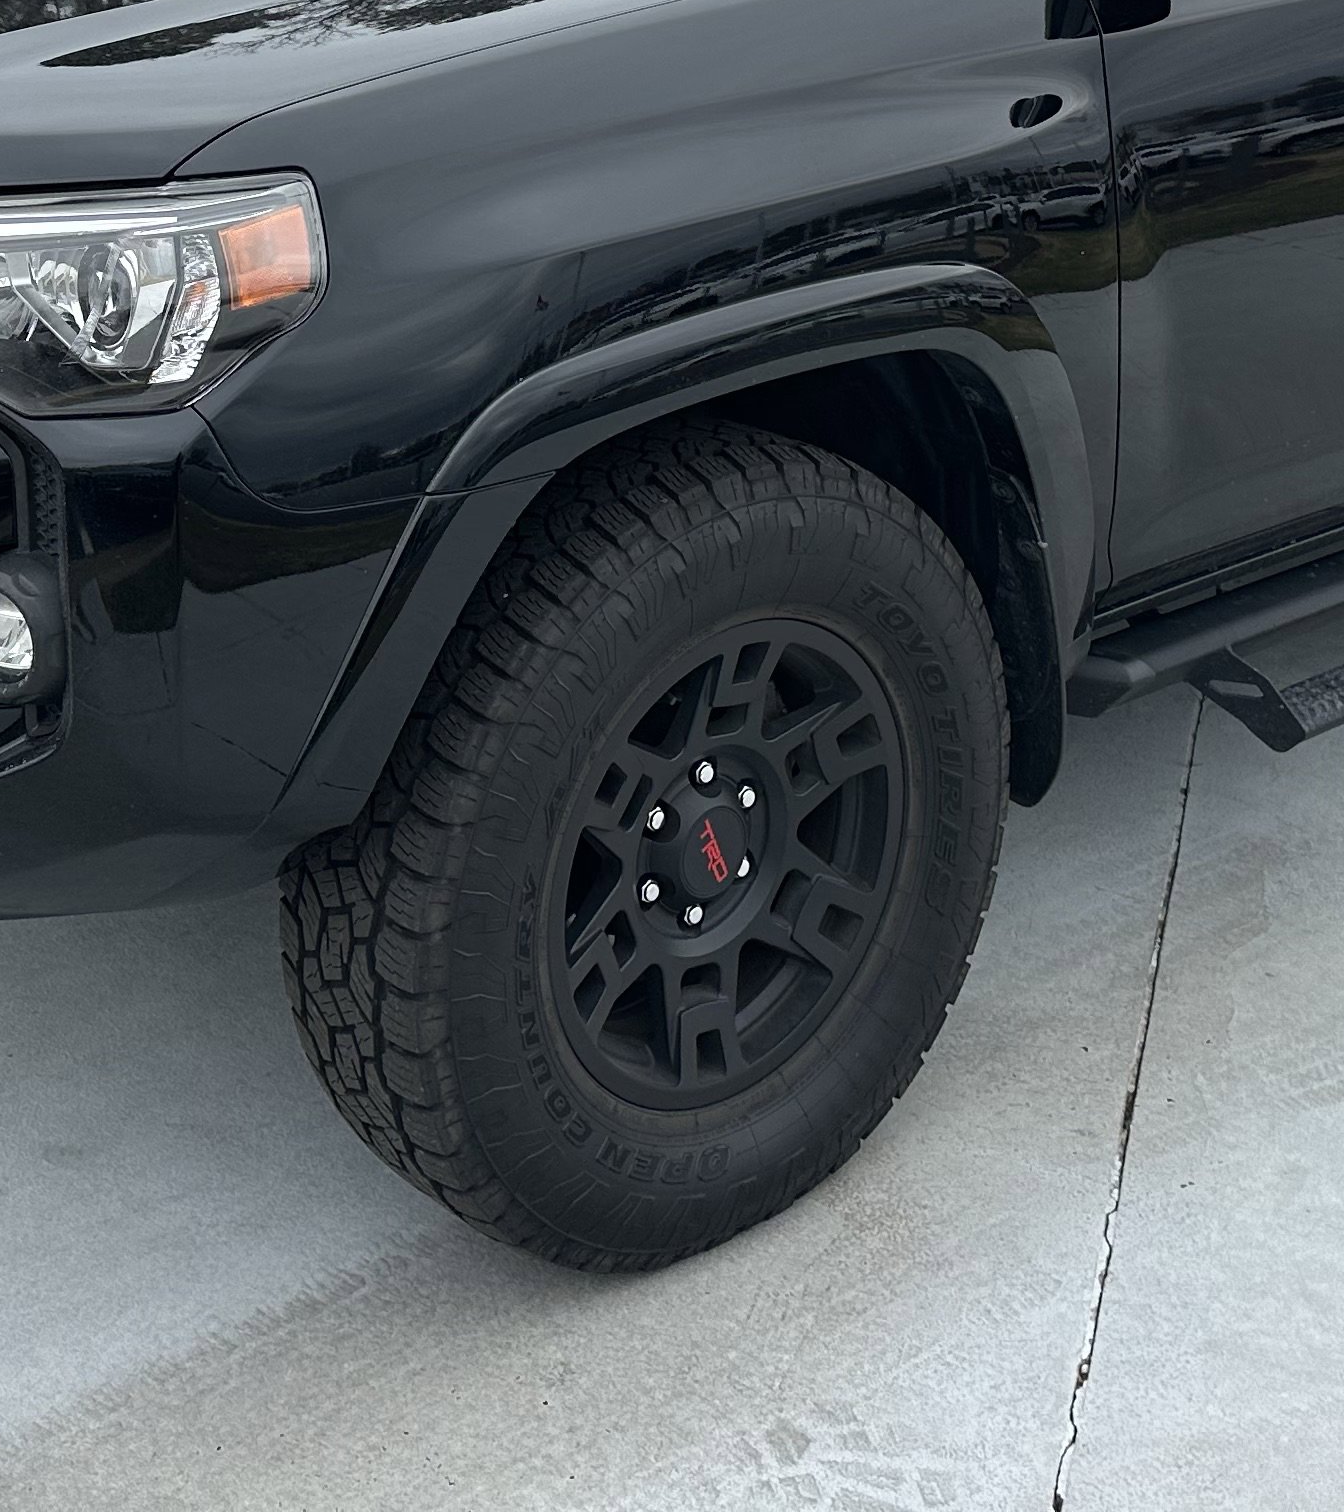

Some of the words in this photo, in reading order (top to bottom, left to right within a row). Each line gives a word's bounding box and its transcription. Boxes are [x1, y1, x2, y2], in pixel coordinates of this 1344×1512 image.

[852, 580, 950, 697] TOYO
[925, 706, 965, 917] TIRES
[699, 818, 729, 883] TRD
[515, 863, 593, 1148] COUNTRY
[595, 1137, 731, 1185] OPEN
